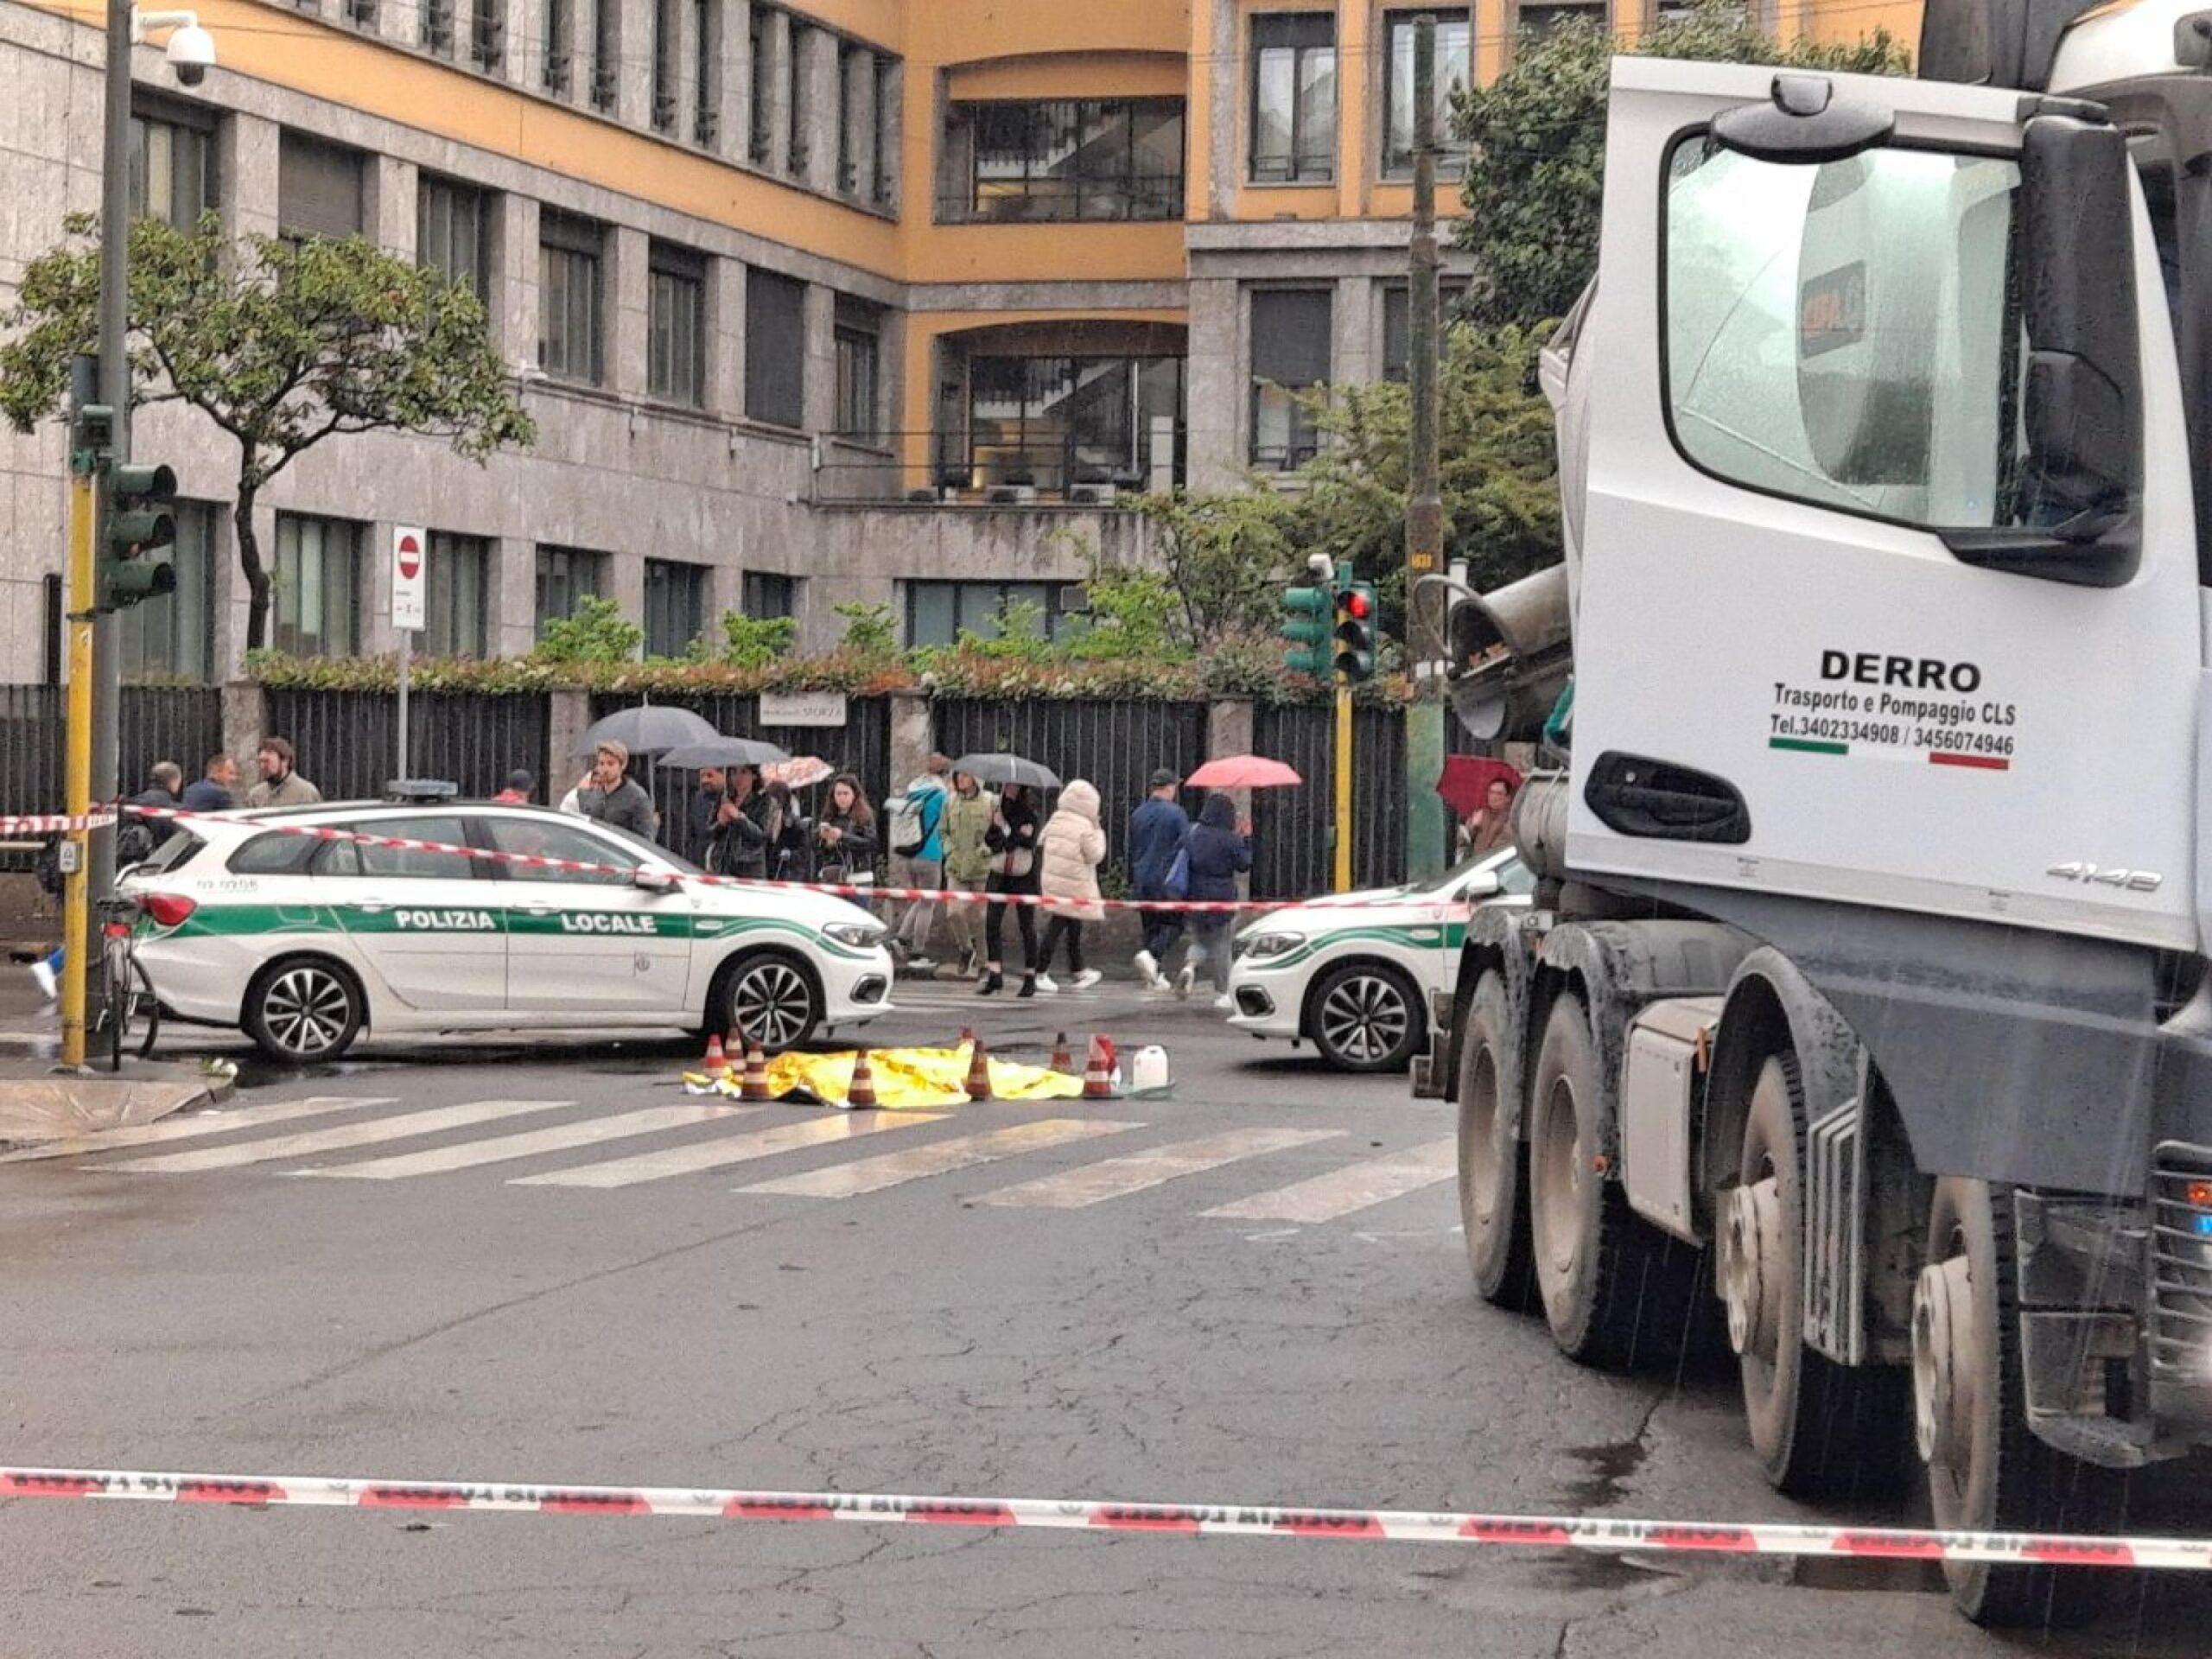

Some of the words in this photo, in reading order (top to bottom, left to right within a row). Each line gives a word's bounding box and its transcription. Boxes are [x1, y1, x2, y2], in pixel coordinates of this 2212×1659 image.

[1821, 650, 1980, 693] DERRO
[1774, 682, 1859, 712] Trasporto
[1864, 695, 1874, 710] e
[1880, 692, 1976, 726] Pompaggio
[1982, 702, 2016, 726] CLS
[1771, 714, 1898, 744] Tel.3402334908
[1903, 727, 1910, 746] /
[1914, 728, 2014, 754] 3456074946
[395, 911, 496, 929] POLIZIA
[562, 913, 657, 933] LOCALE
